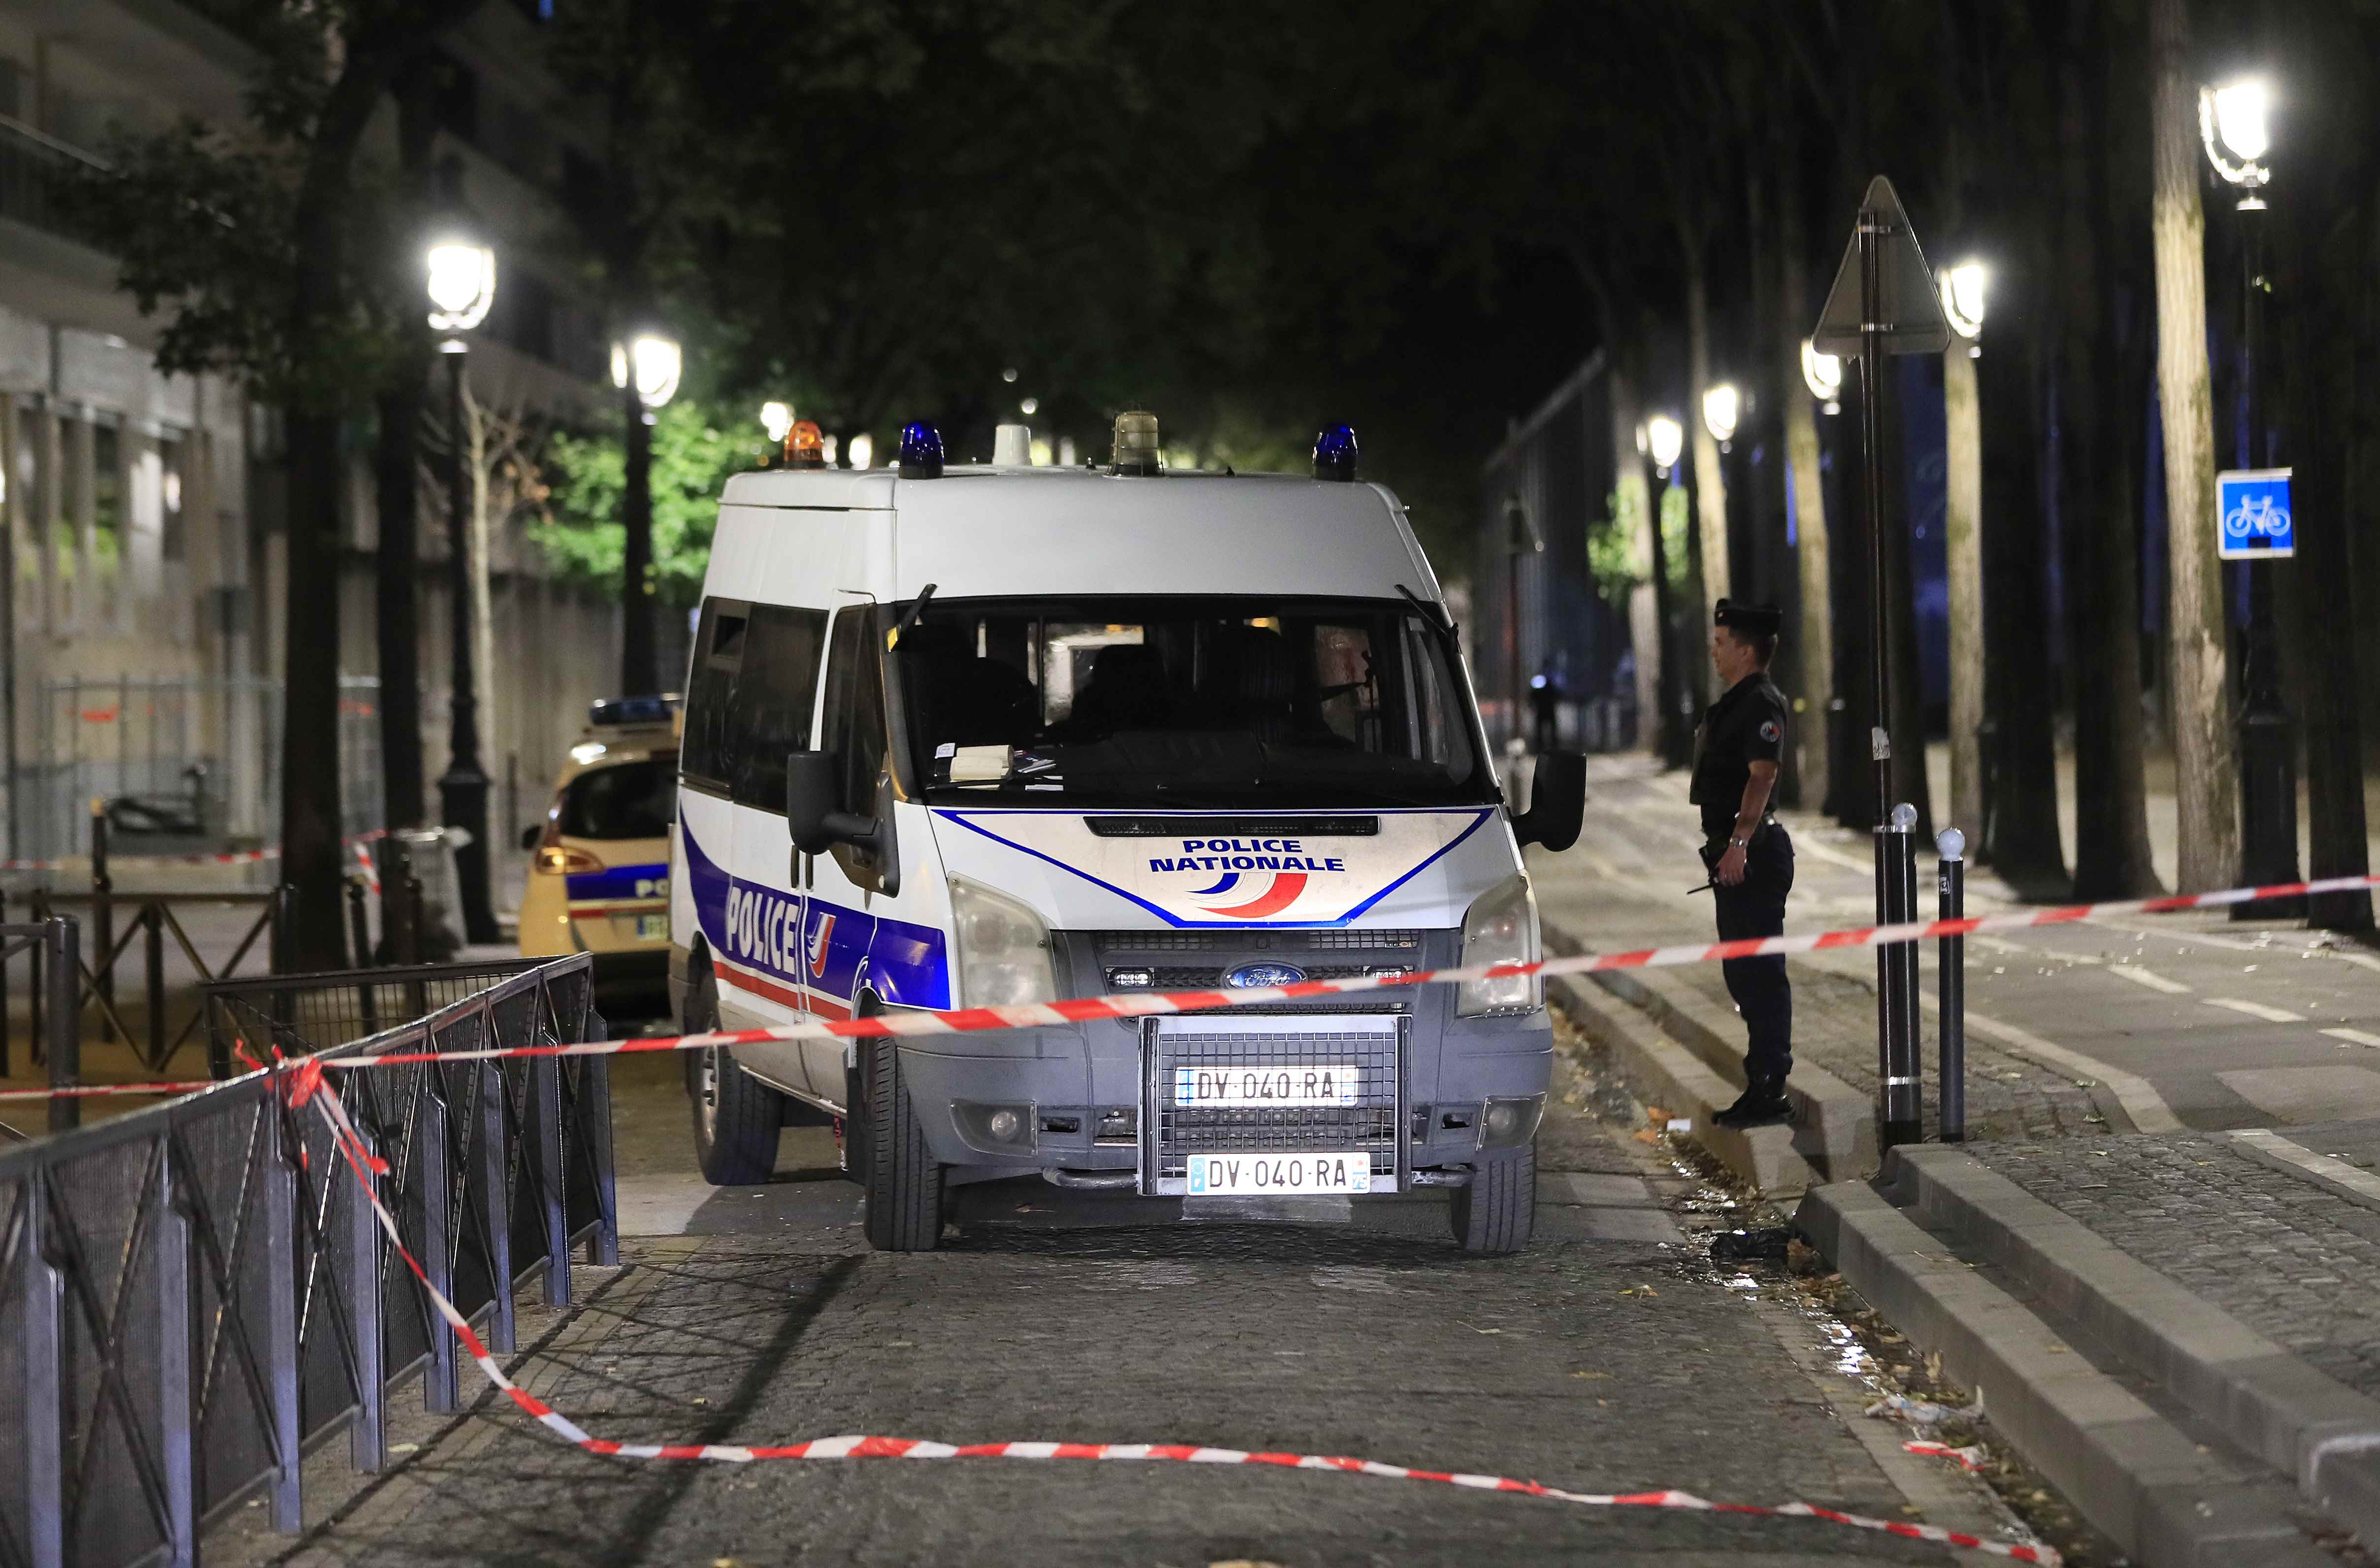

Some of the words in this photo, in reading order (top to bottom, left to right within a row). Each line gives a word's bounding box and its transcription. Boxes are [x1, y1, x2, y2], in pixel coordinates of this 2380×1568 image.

[1183, 839, 1303, 853] POLICE
[1149, 856, 1345, 872] NATIONALE
[726, 886, 799, 975] POLICE
